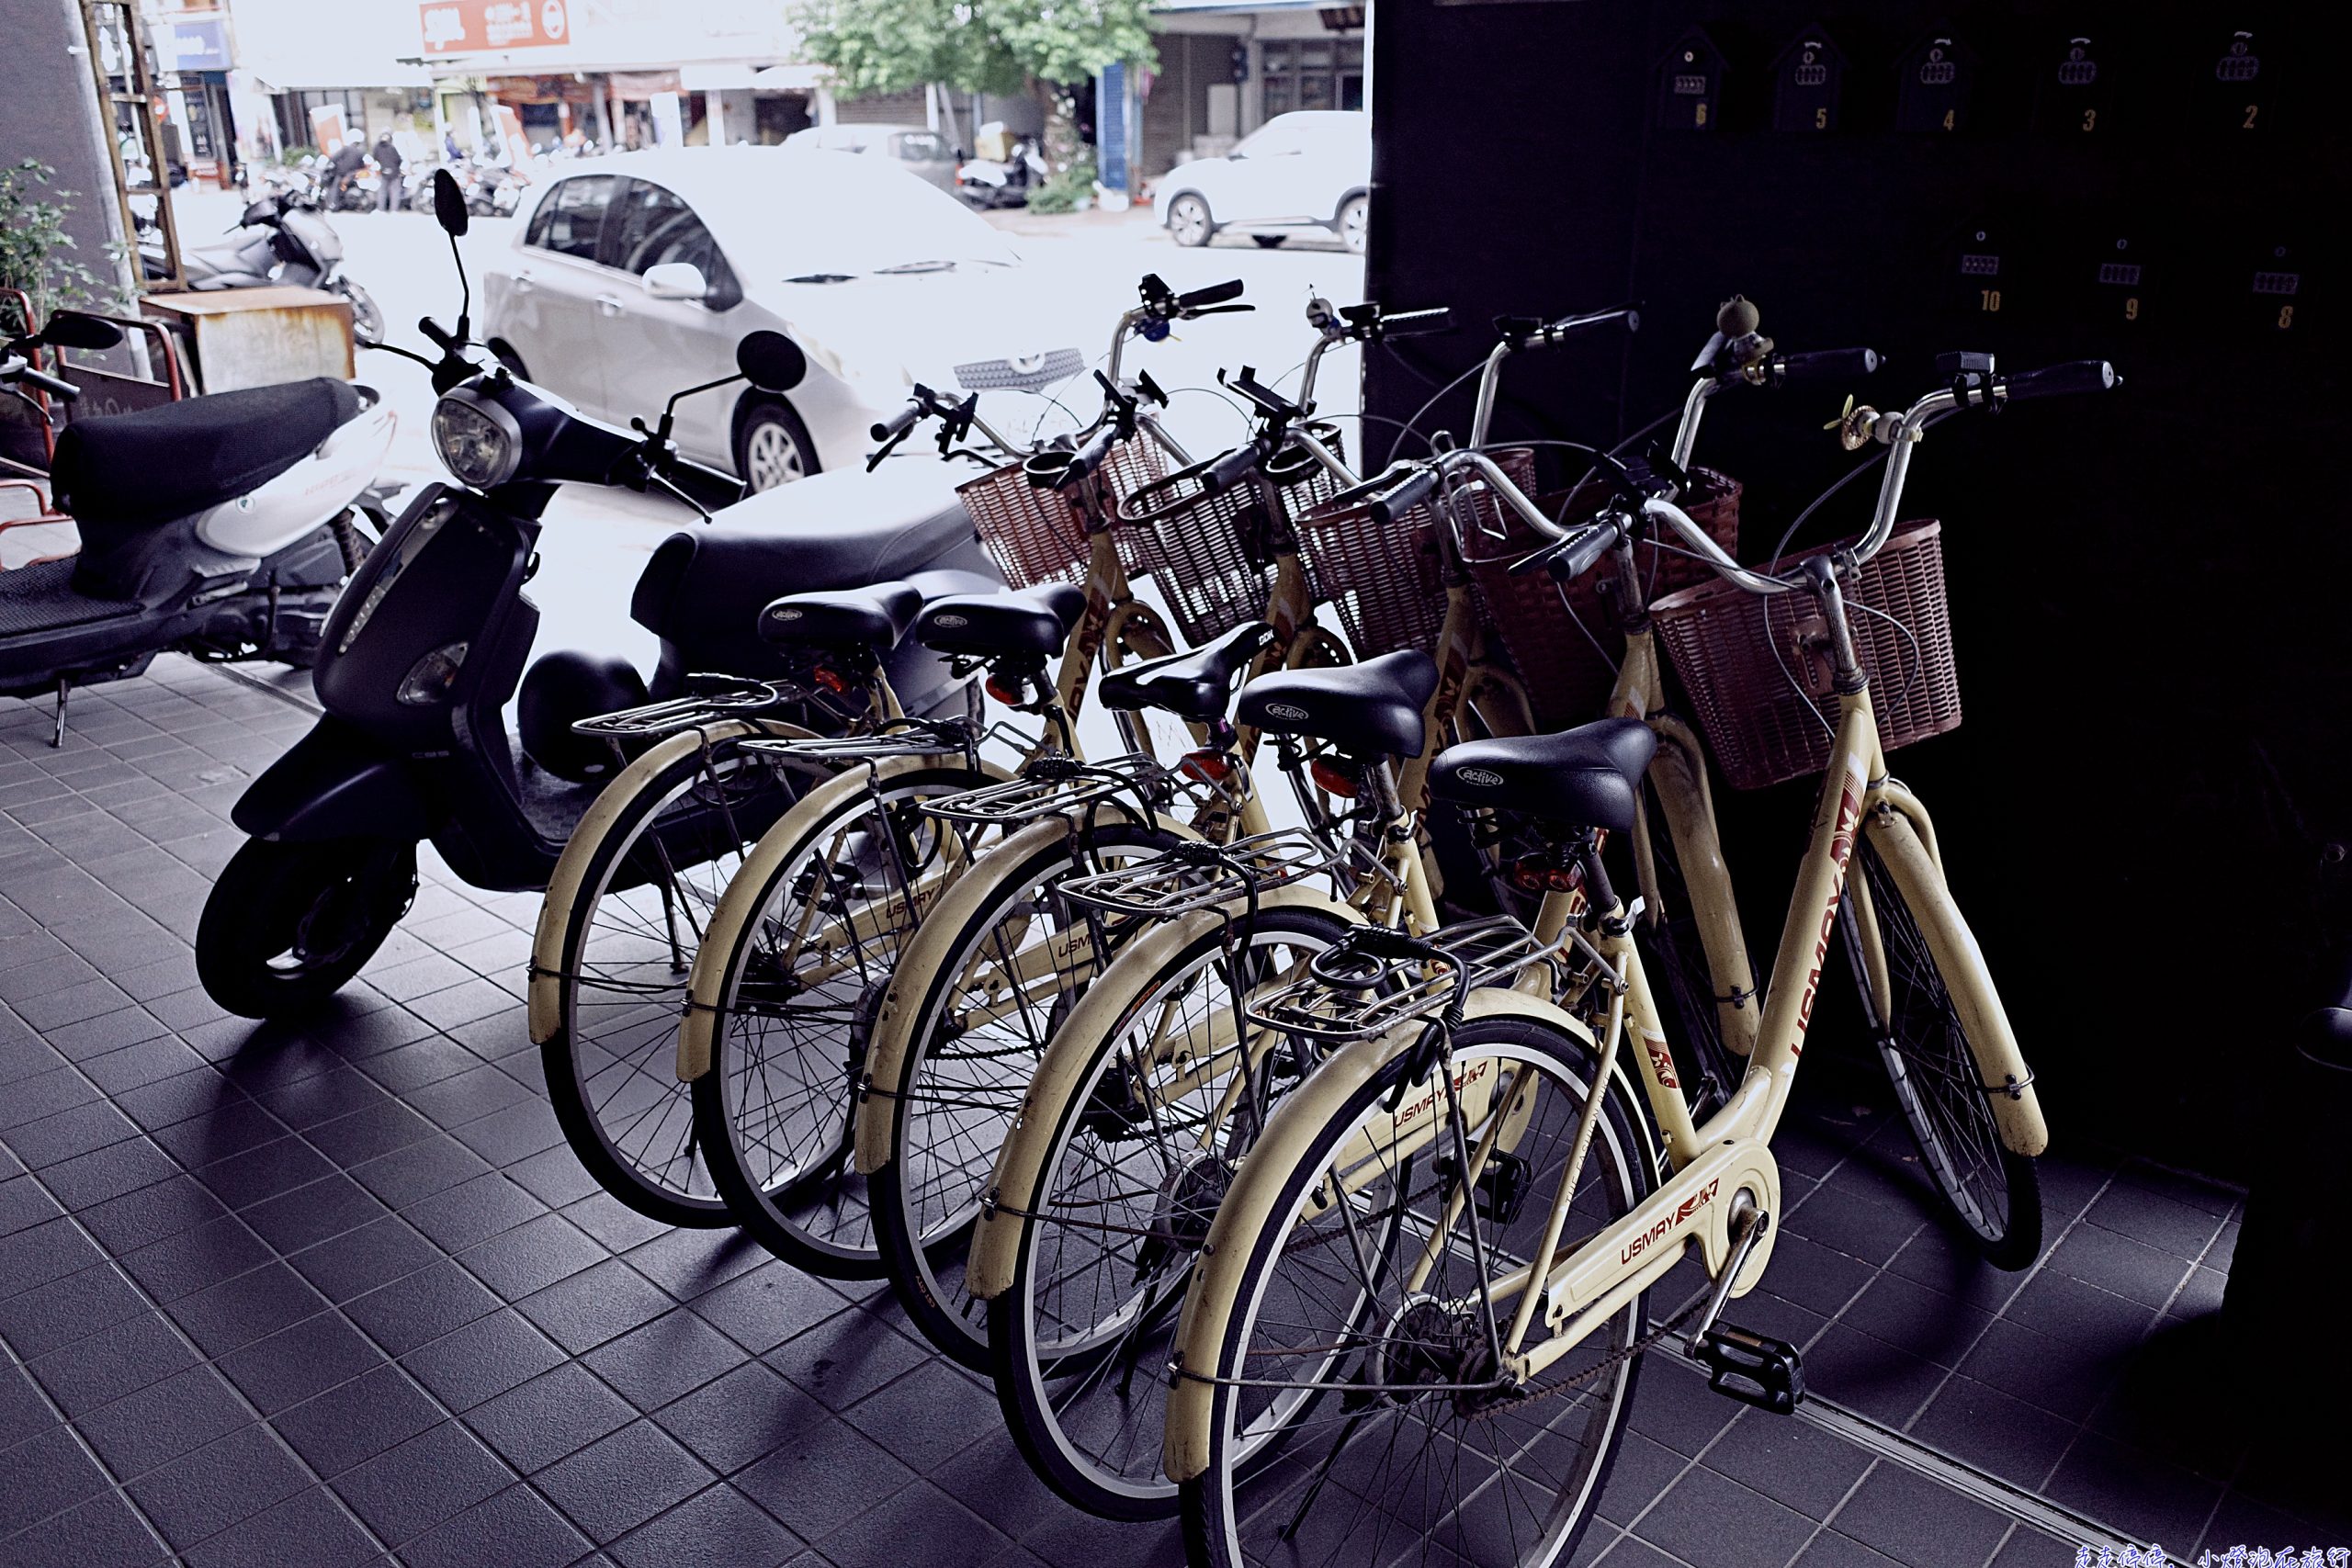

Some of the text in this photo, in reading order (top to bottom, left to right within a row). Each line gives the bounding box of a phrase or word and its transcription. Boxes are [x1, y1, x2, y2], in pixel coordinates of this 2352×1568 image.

[1695, 103, 1707, 126] 6
[1815, 107, 1827, 130] 5
[1941, 108, 1955, 131] 4
[2082, 108, 2098, 132] 3
[2242, 104, 2259, 130] 2
[1980, 289, 2001, 313] 10
[2125, 297, 2139, 321] 9
[2278, 305, 2294, 329] 8
[1463, 769, 1498, 785] active
